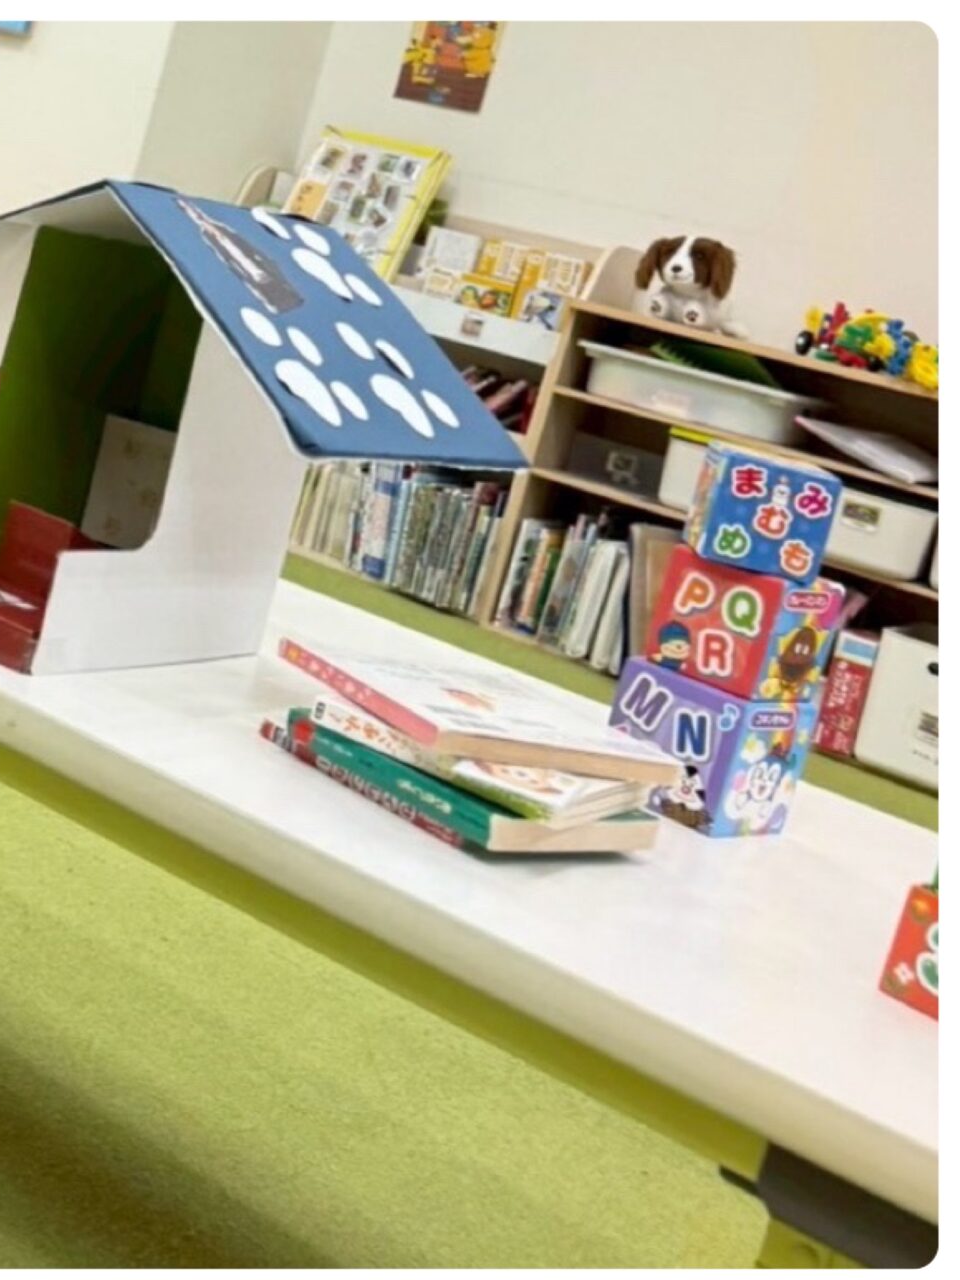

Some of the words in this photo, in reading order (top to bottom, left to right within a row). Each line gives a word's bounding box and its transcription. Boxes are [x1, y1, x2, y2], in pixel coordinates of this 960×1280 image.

[732, 465, 767, 497] ま
[795, 483, 831, 517] み
[753, 503, 792, 539] む
[714, 524, 751, 557] め
[780, 540, 813, 575] も
[674, 571, 715, 614] P
[722, 585, 763, 636] Q
[696, 629, 733, 675] R
[620, 673, 673, 732] M
[673, 706, 710, 761] N
